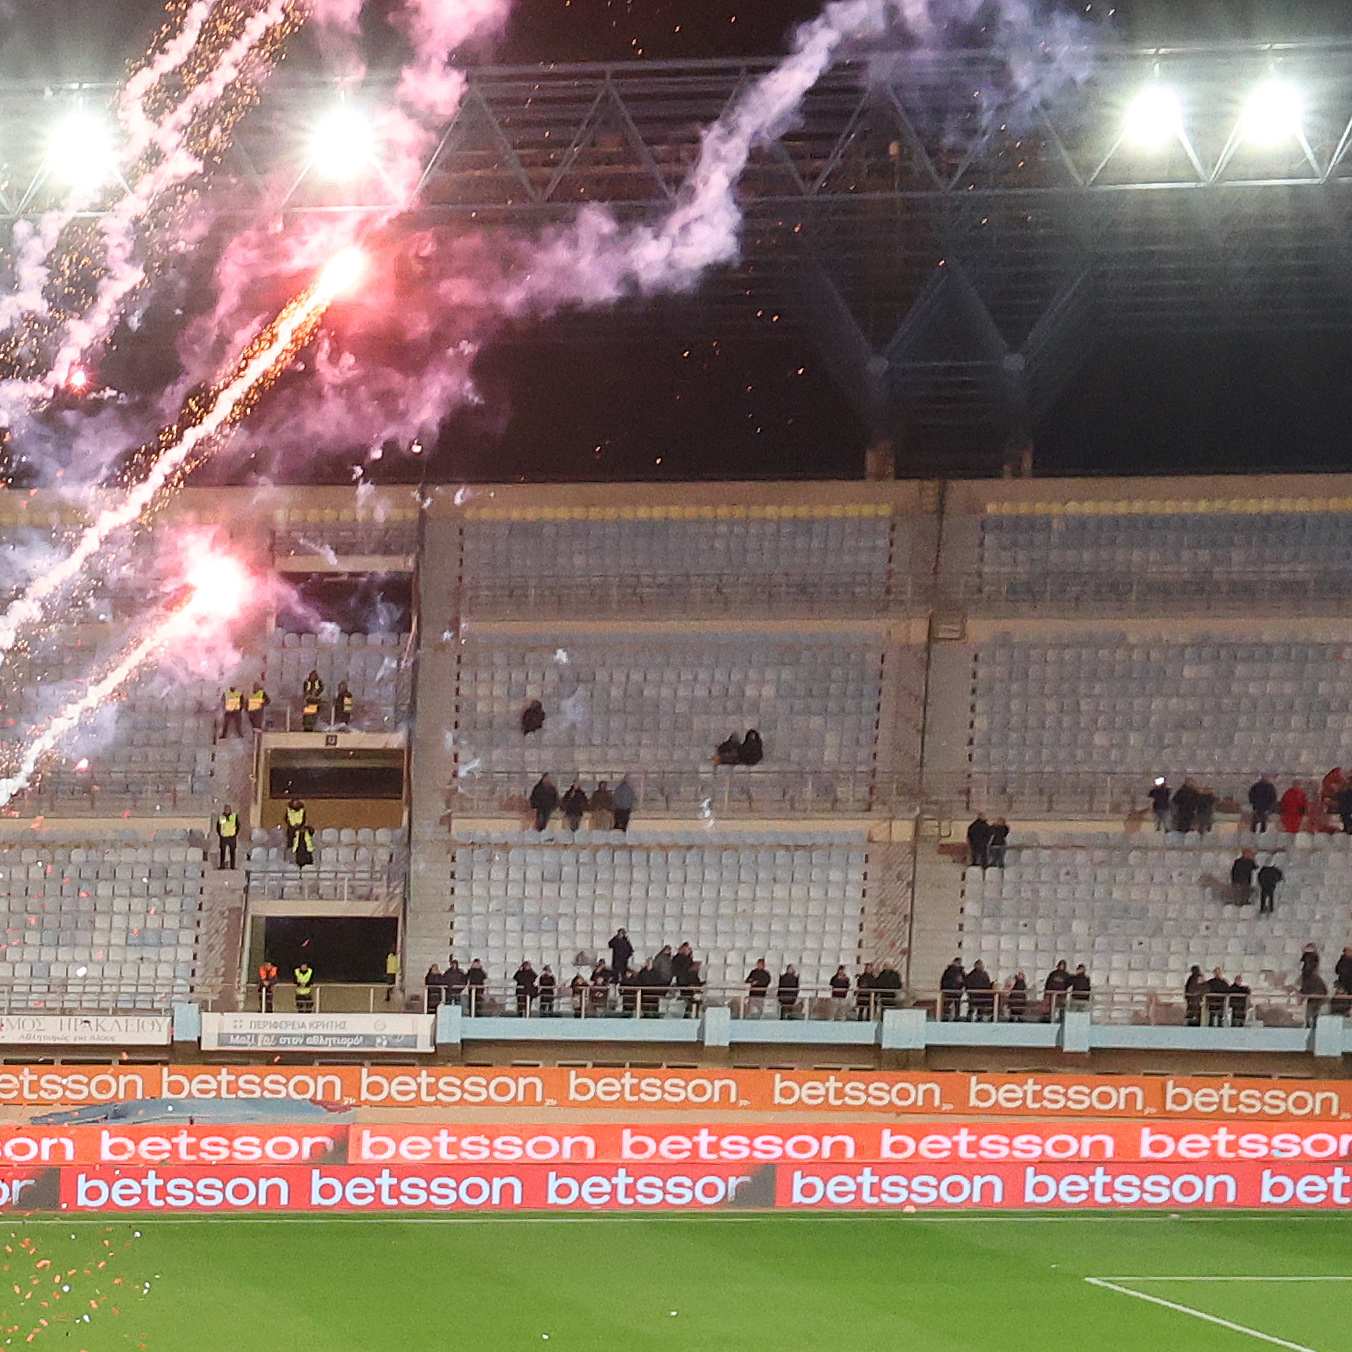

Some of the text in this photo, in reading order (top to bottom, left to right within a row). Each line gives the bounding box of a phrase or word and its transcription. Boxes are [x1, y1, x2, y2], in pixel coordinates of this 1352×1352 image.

[59, 1017, 168, 1033] ΗΡΑΚΛΕΙΟΥ
[250, 1020, 348, 1030] ΠΕΡΙΦΕΡΕΙΑ ΚΡΗΤΗΣ
[161, 1067, 341, 1101] betsson
[361, 1069, 543, 1103] betsson
[569, 1070, 736, 1104] betsson
[774, 1073, 940, 1109] betsson
[970, 1076, 1144, 1110] betsson
[1165, 1079, 1339, 1115] betsson
[362, 1129, 596, 1160] betsson
[623, 1128, 856, 1161] betsson
[881, 1128, 1115, 1160] betsson
[77, 1169, 290, 1207] betsson
[310, 1168, 523, 1206] betsson
[792, 1167, 1003, 1204] betsson
[1025, 1167, 1237, 1203] betsson
